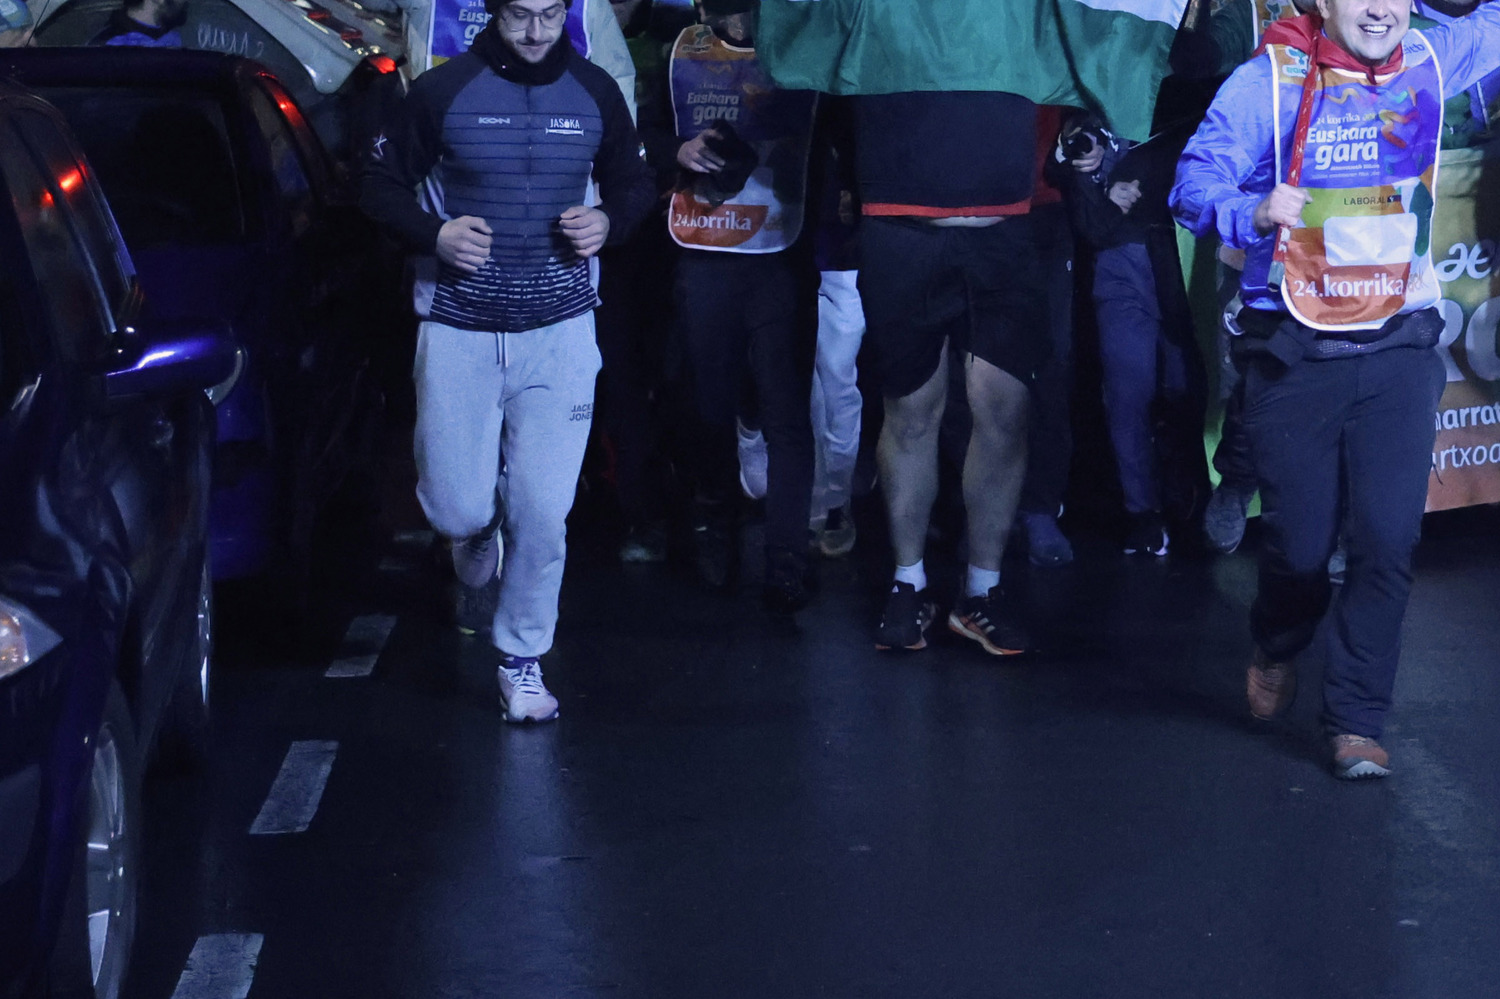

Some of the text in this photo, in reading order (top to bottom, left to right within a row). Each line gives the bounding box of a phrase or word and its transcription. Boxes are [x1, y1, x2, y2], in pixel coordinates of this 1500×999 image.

[687, 92, 739, 105] Euskara
[693, 105, 739, 126] gara
[1327, 113, 1360, 124] korrika
[1306, 125, 1378, 144] Euskara
[1315, 141, 1379, 170] gara
[674, 211, 752, 231] 24.korrika
[1294, 272, 1404, 298] 24.korrika
[569, 411, 593, 421] JONE
